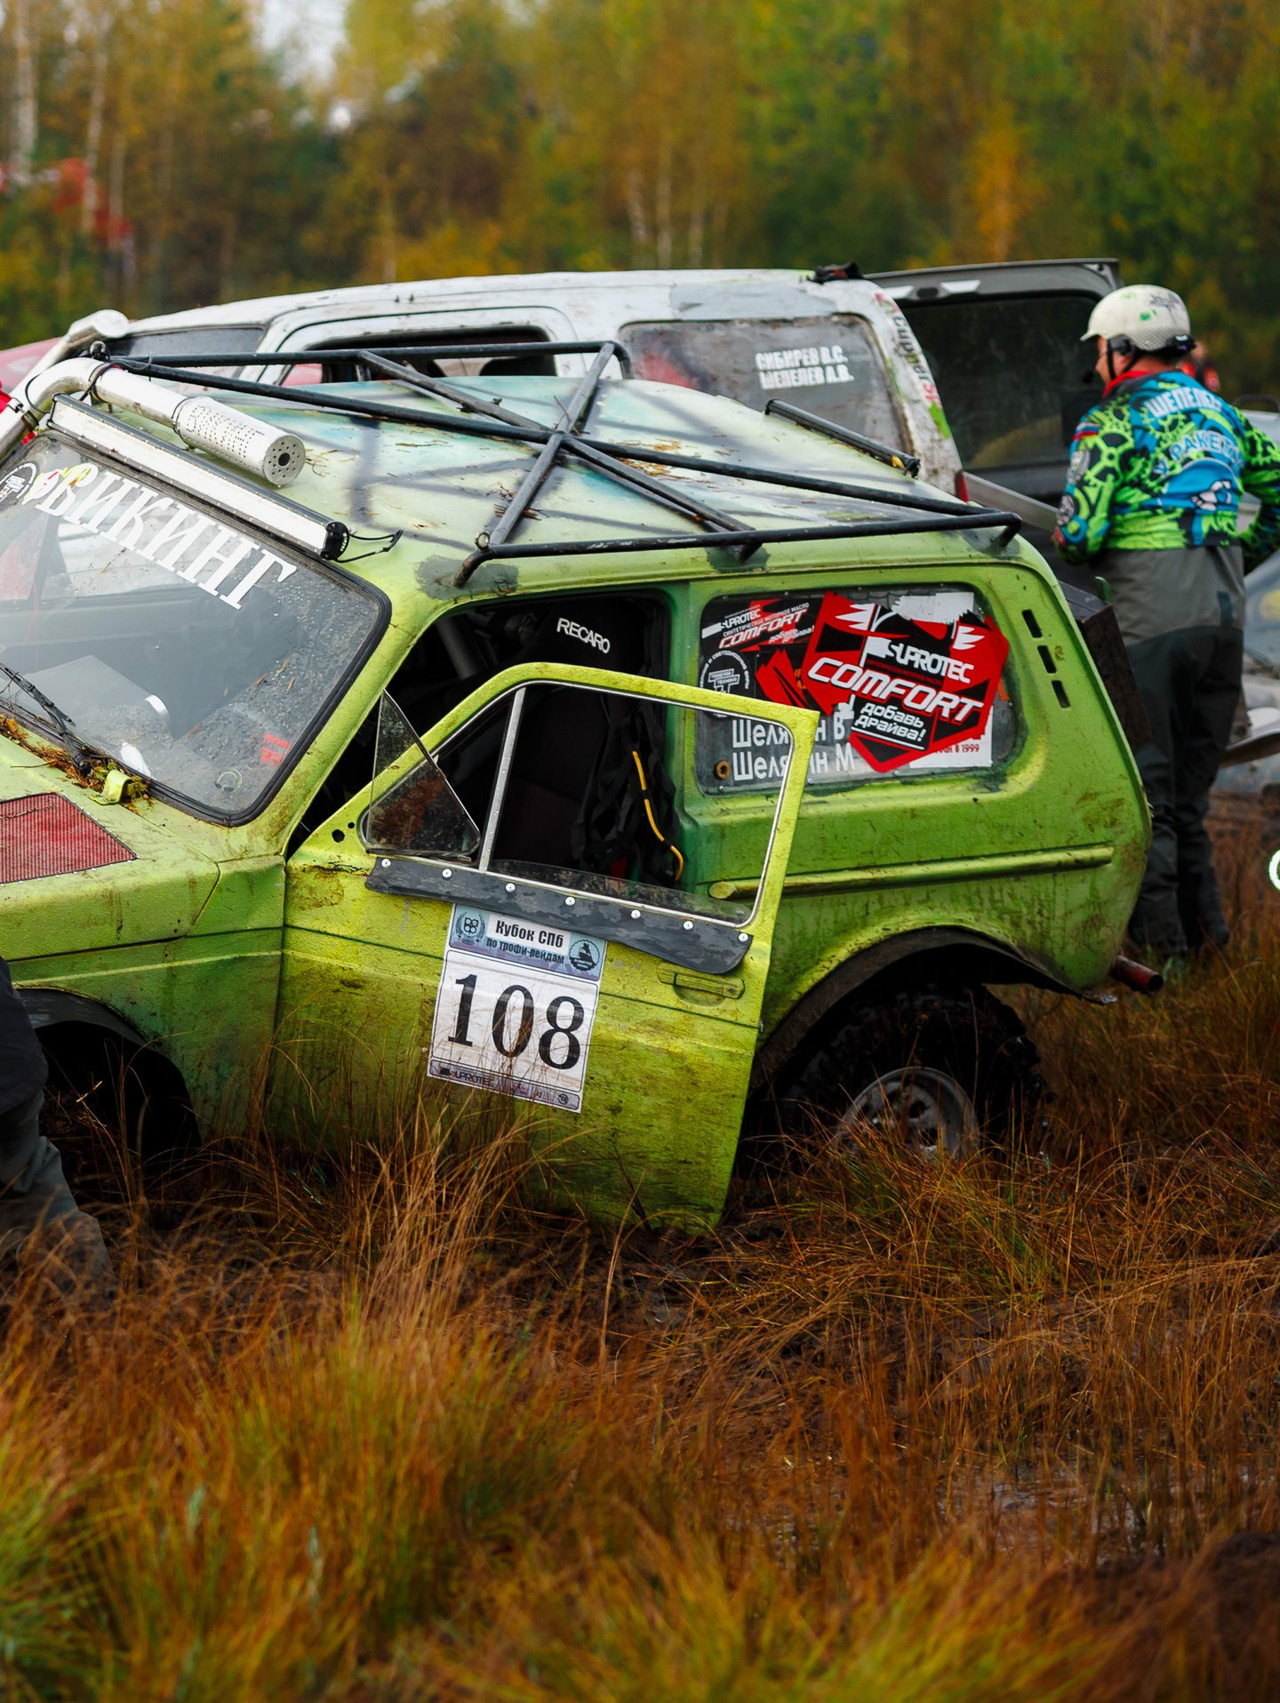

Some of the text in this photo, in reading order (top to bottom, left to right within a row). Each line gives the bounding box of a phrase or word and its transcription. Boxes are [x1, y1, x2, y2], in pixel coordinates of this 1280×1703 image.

[35, 461, 299, 610] ВИКИНГ
[556, 617, 611, 654] RECARO
[718, 609, 808, 649] COMFORT
[888, 641, 974, 684] SUPROTEC
[807, 656, 984, 722] COMFORT
[854, 715, 927, 742] драйва!
[860, 702, 925, 728] добавь
[835, 742, 856, 772] М
[961, 743, 980, 753] 1999
[495, 920, 564, 948] Кубок СПб
[486, 938, 498, 948] по
[499, 940, 565, 964] трофи-рейдам
[448, 973, 584, 1070] 108
